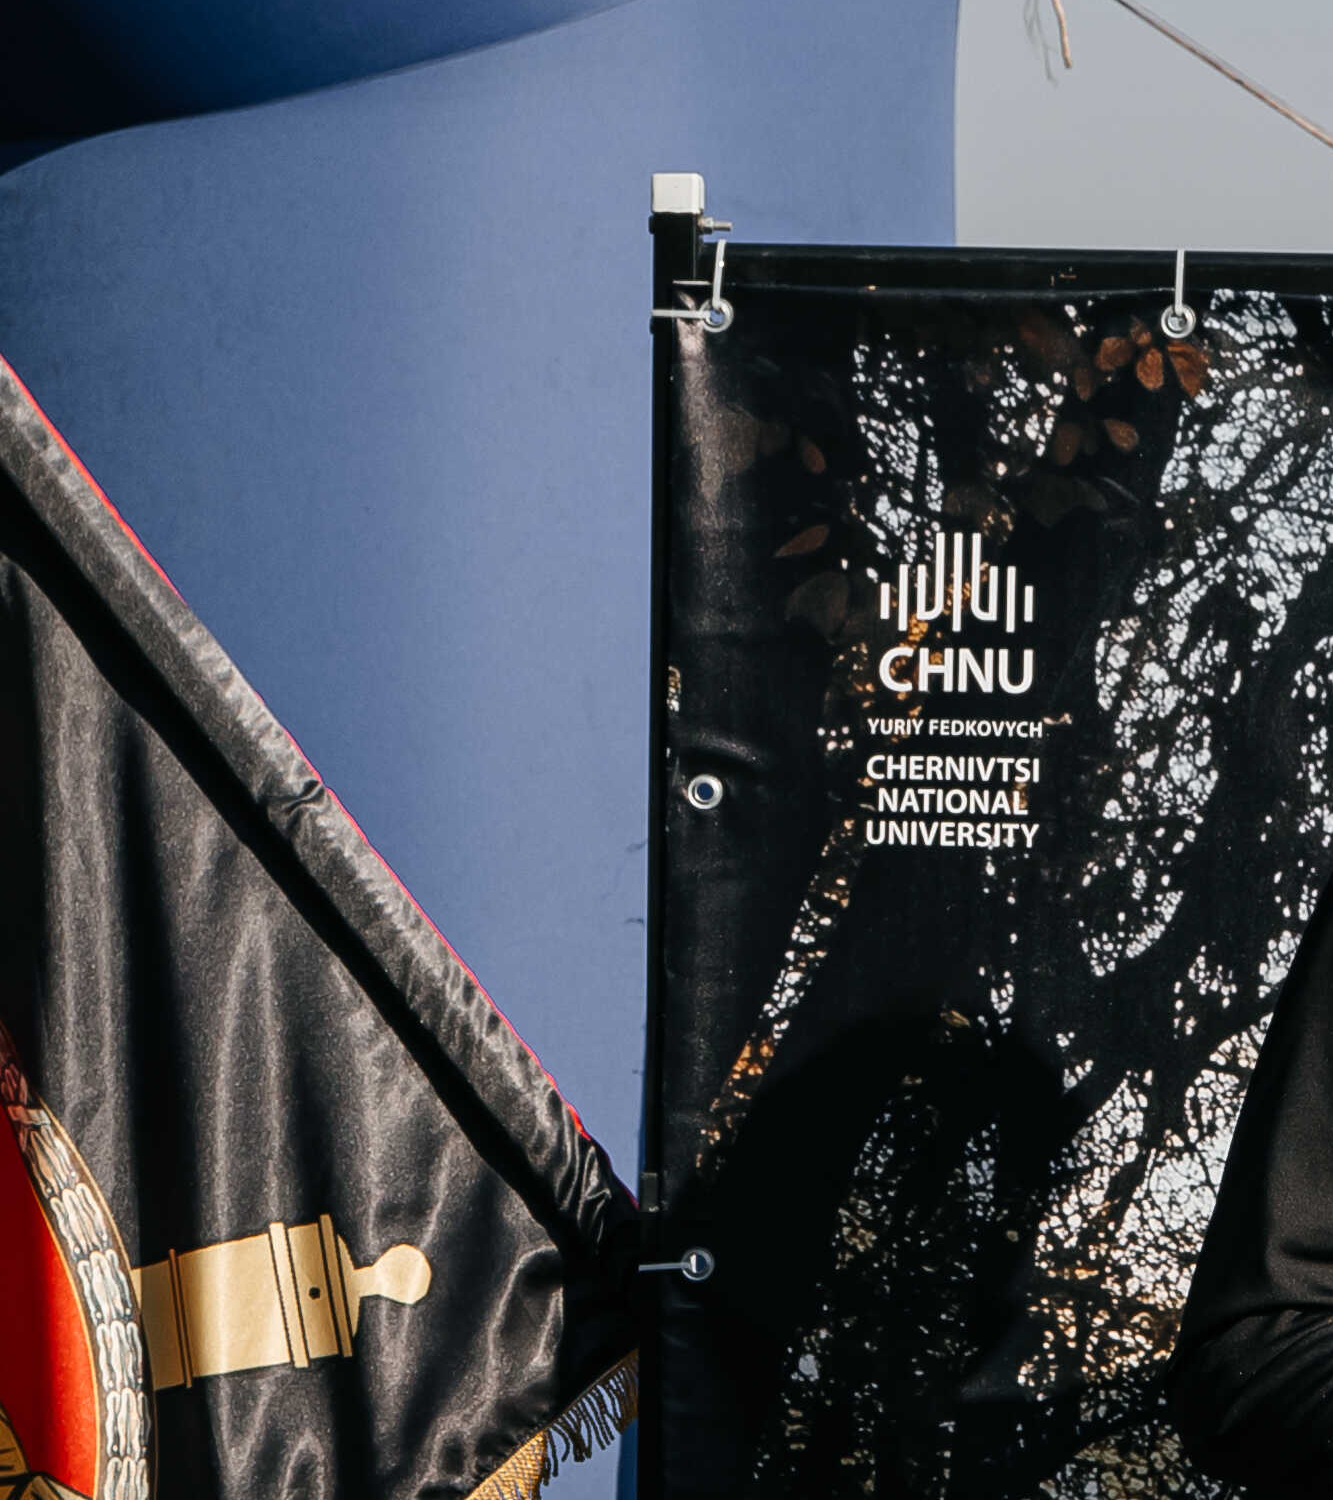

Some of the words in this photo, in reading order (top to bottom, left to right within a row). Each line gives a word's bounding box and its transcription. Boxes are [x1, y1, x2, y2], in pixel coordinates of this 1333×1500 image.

[878, 646, 1034, 694] CHNU
[867, 717, 923, 736] YURIY
[928, 718, 1043, 739] FEDKOVYCH
[866, 754, 1040, 783] CHERNIVTSI
[877, 787, 1028, 816] NATIONAL
[866, 819, 1040, 849] UNIVERSITY
